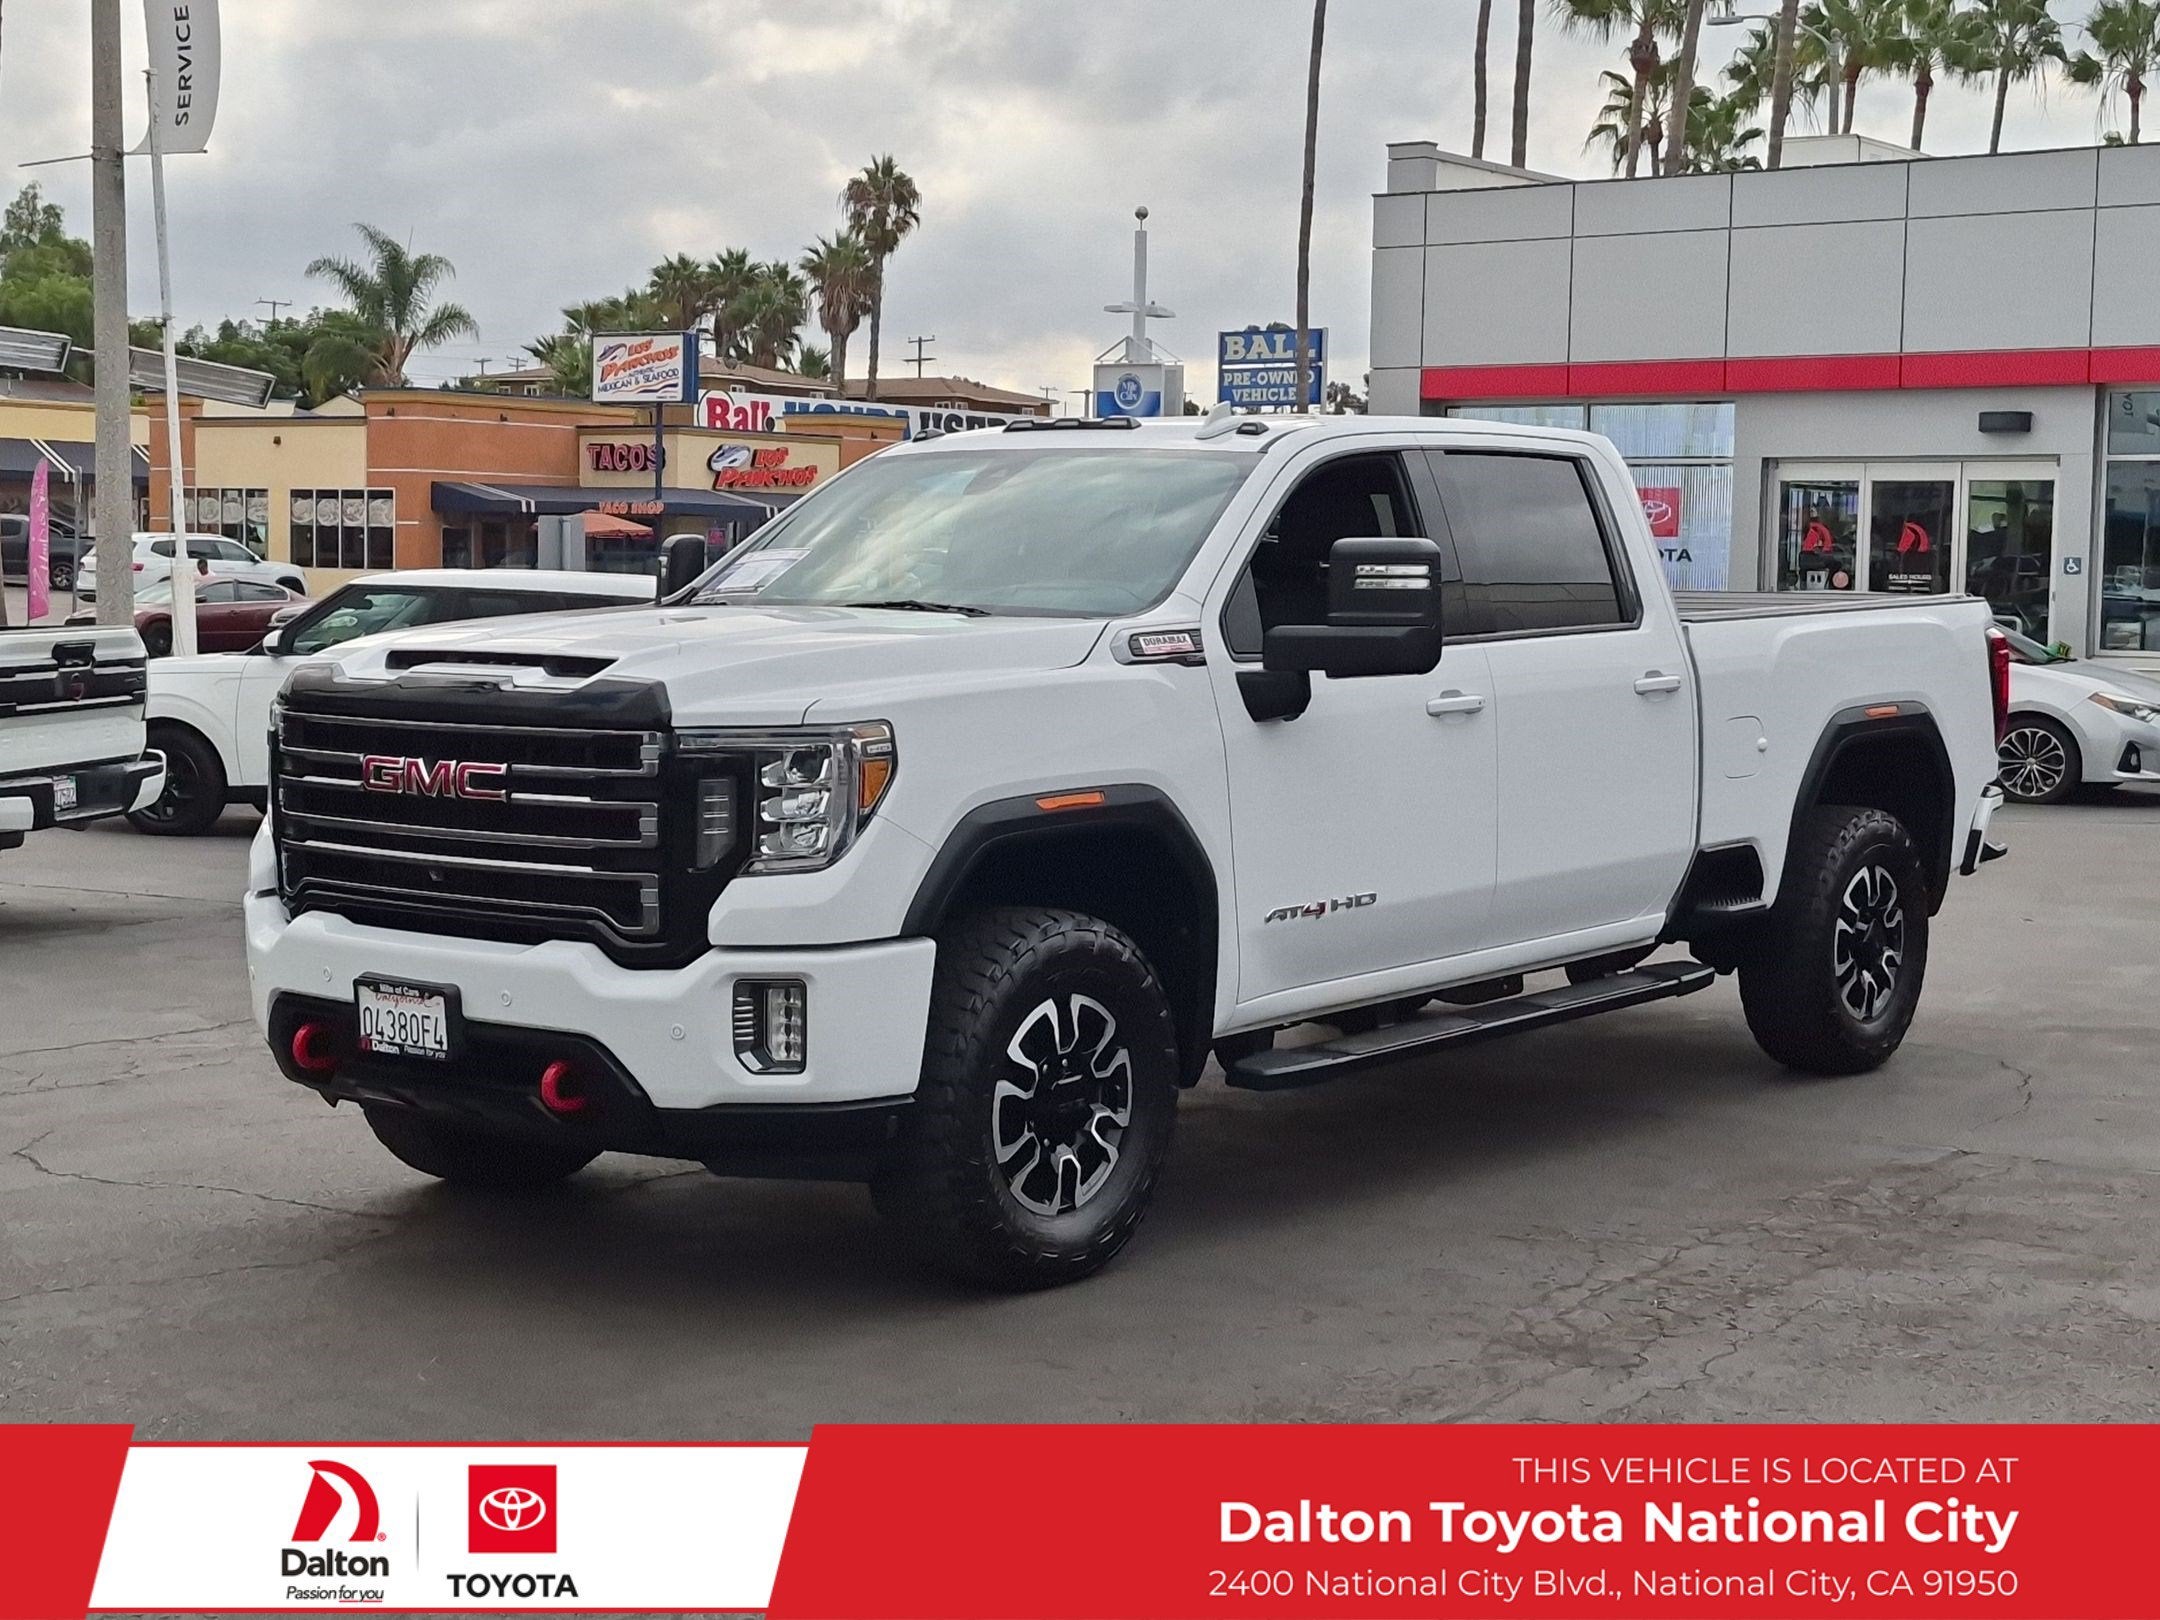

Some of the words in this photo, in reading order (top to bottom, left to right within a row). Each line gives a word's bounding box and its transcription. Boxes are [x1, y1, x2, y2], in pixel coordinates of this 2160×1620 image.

[174, 5, 192, 126] SERVICE
[598, 379, 633, 393] MEXICAN
[642, 368, 680, 383] SEAFOOD
[586, 443, 663, 471] TACOS
[752, 446, 789, 468] LOS
[715, 464, 818, 489] PANCHOS
[1142, 634, 1190, 647] DURAMAX
[363, 754, 508, 803] GMC
[1264, 900, 1327, 924] AT4
[1330, 891, 1378, 912] HD
[362, 1006, 445, 1049] 04380F4
[372, 1040, 400, 1055] Dalton
